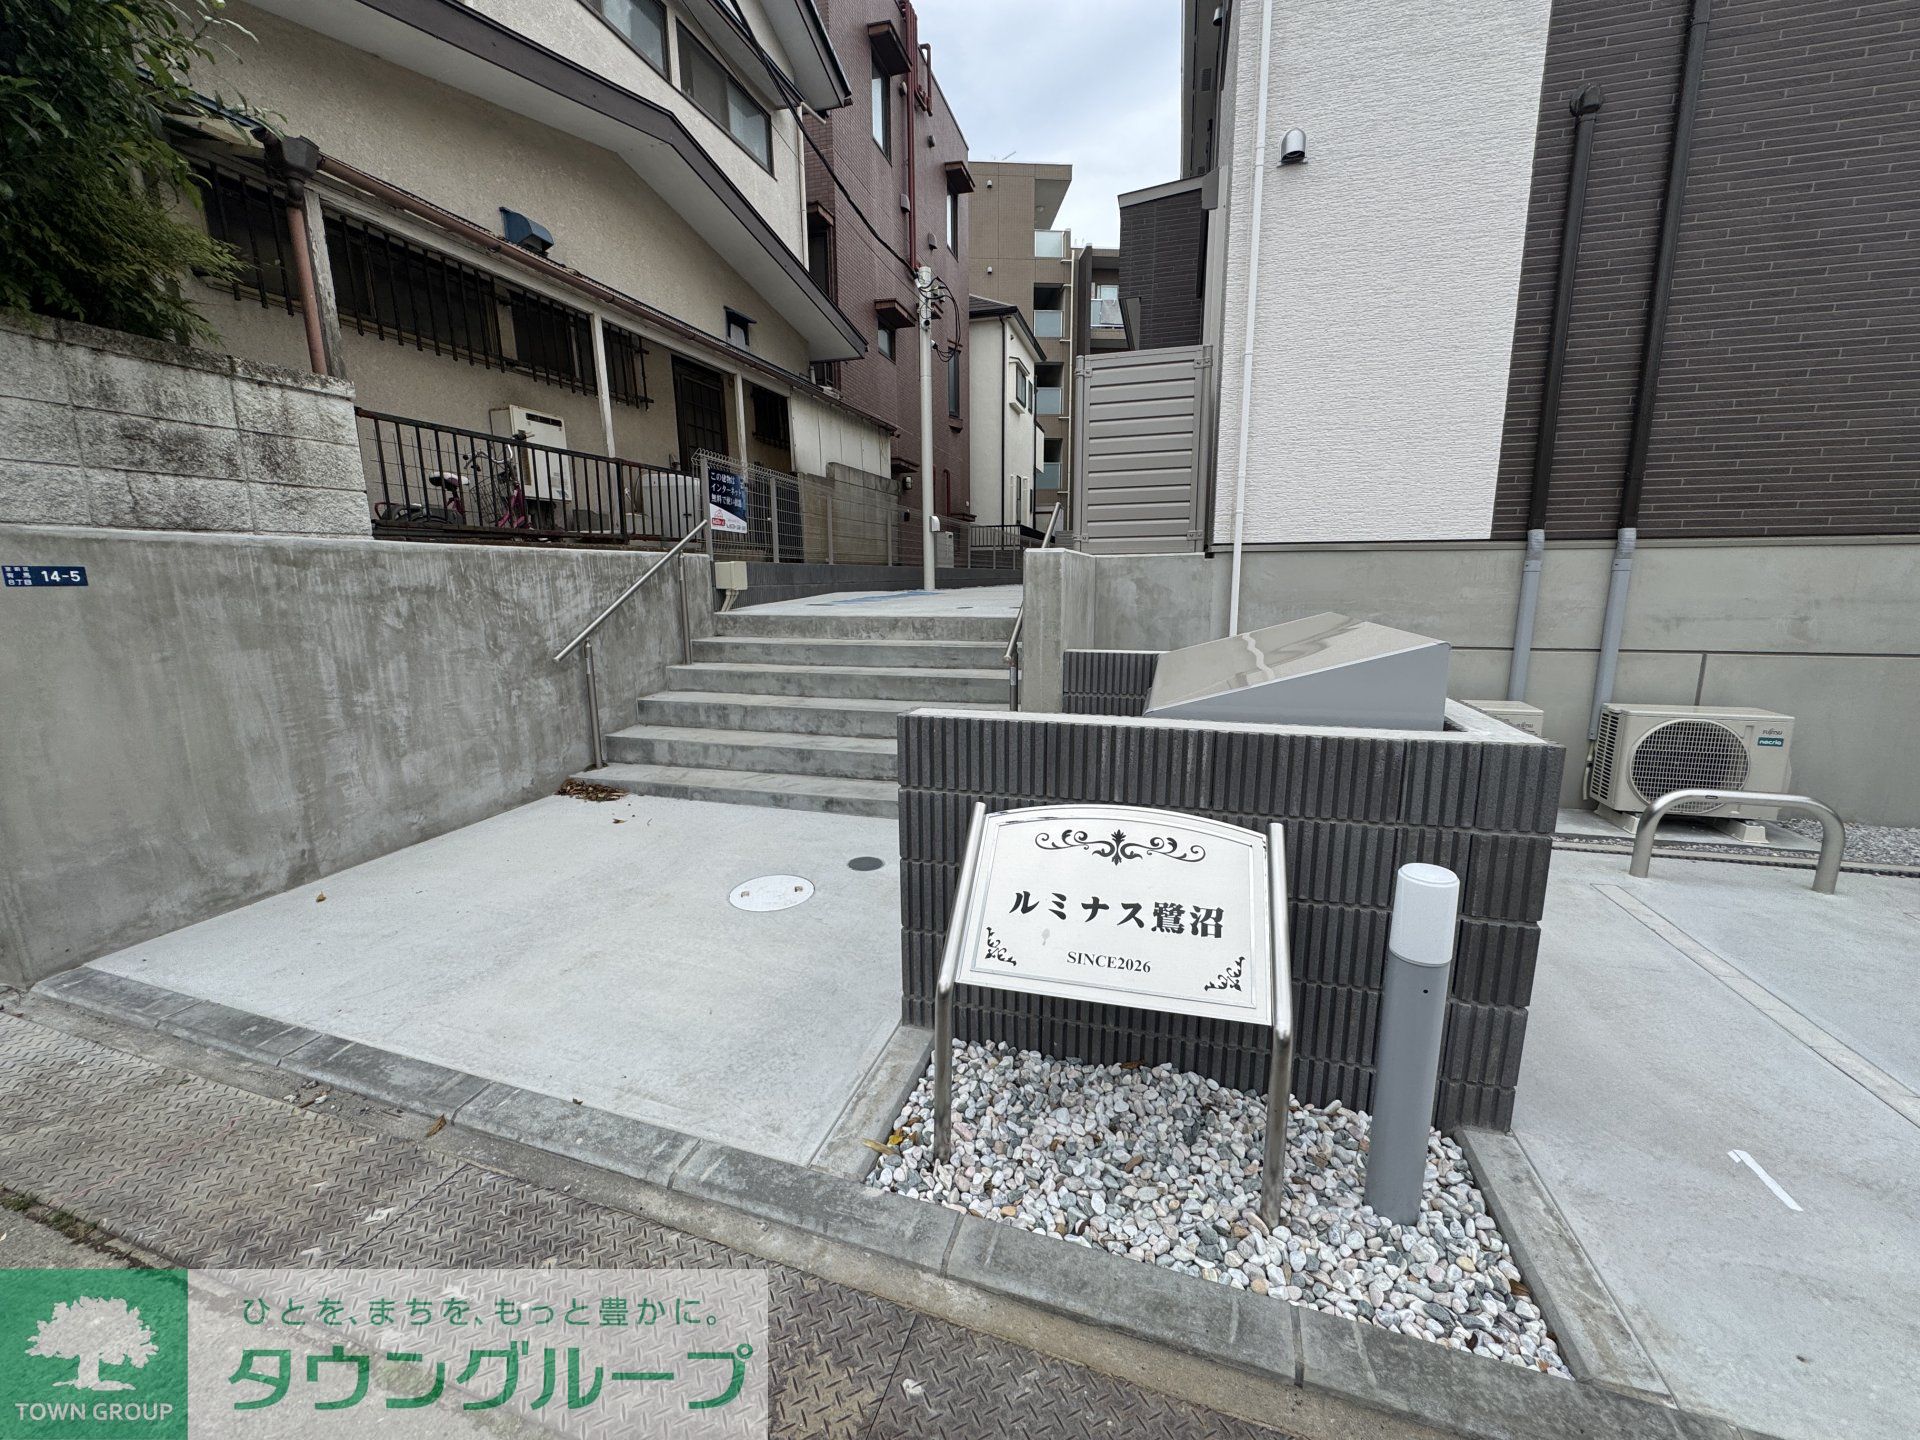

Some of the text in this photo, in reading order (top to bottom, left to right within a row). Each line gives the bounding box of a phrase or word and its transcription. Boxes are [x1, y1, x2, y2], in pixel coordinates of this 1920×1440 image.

[711, 484, 742, 496] インターネット
[41, 570, 81, 582] 14-5
[1009, 890, 1225, 939] ルミナス鷺沼
[1066, 950, 1152, 974] SINCE2026
